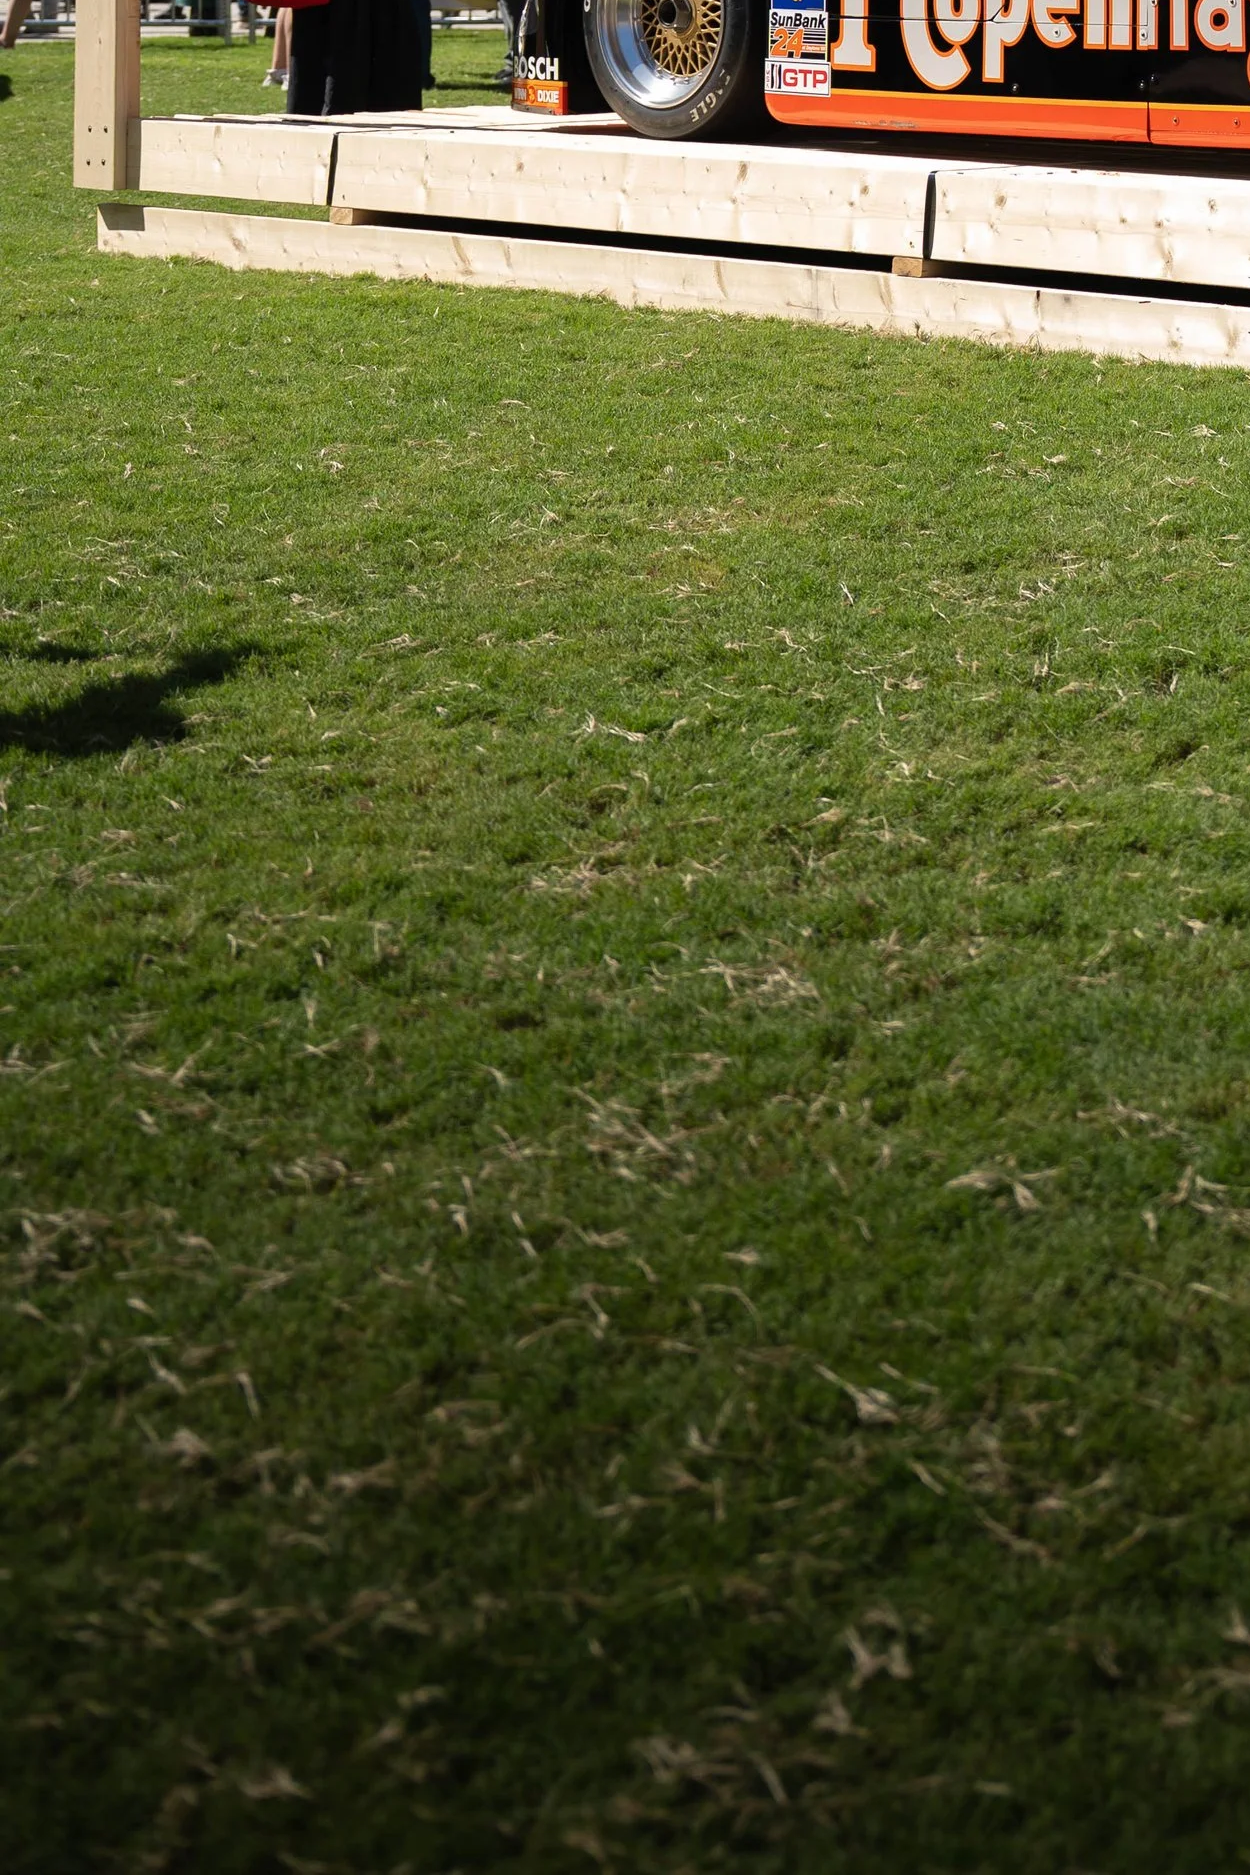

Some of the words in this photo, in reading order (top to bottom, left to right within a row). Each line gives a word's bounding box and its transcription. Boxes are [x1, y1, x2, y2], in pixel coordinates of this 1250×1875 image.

[770, 12, 826, 29] SunBank
[770, 28, 804, 58] 24
[513, 56, 559, 80] BOSCH
[783, 68, 828, 88] GTP
[537, 90, 559, 104] DIXIE
